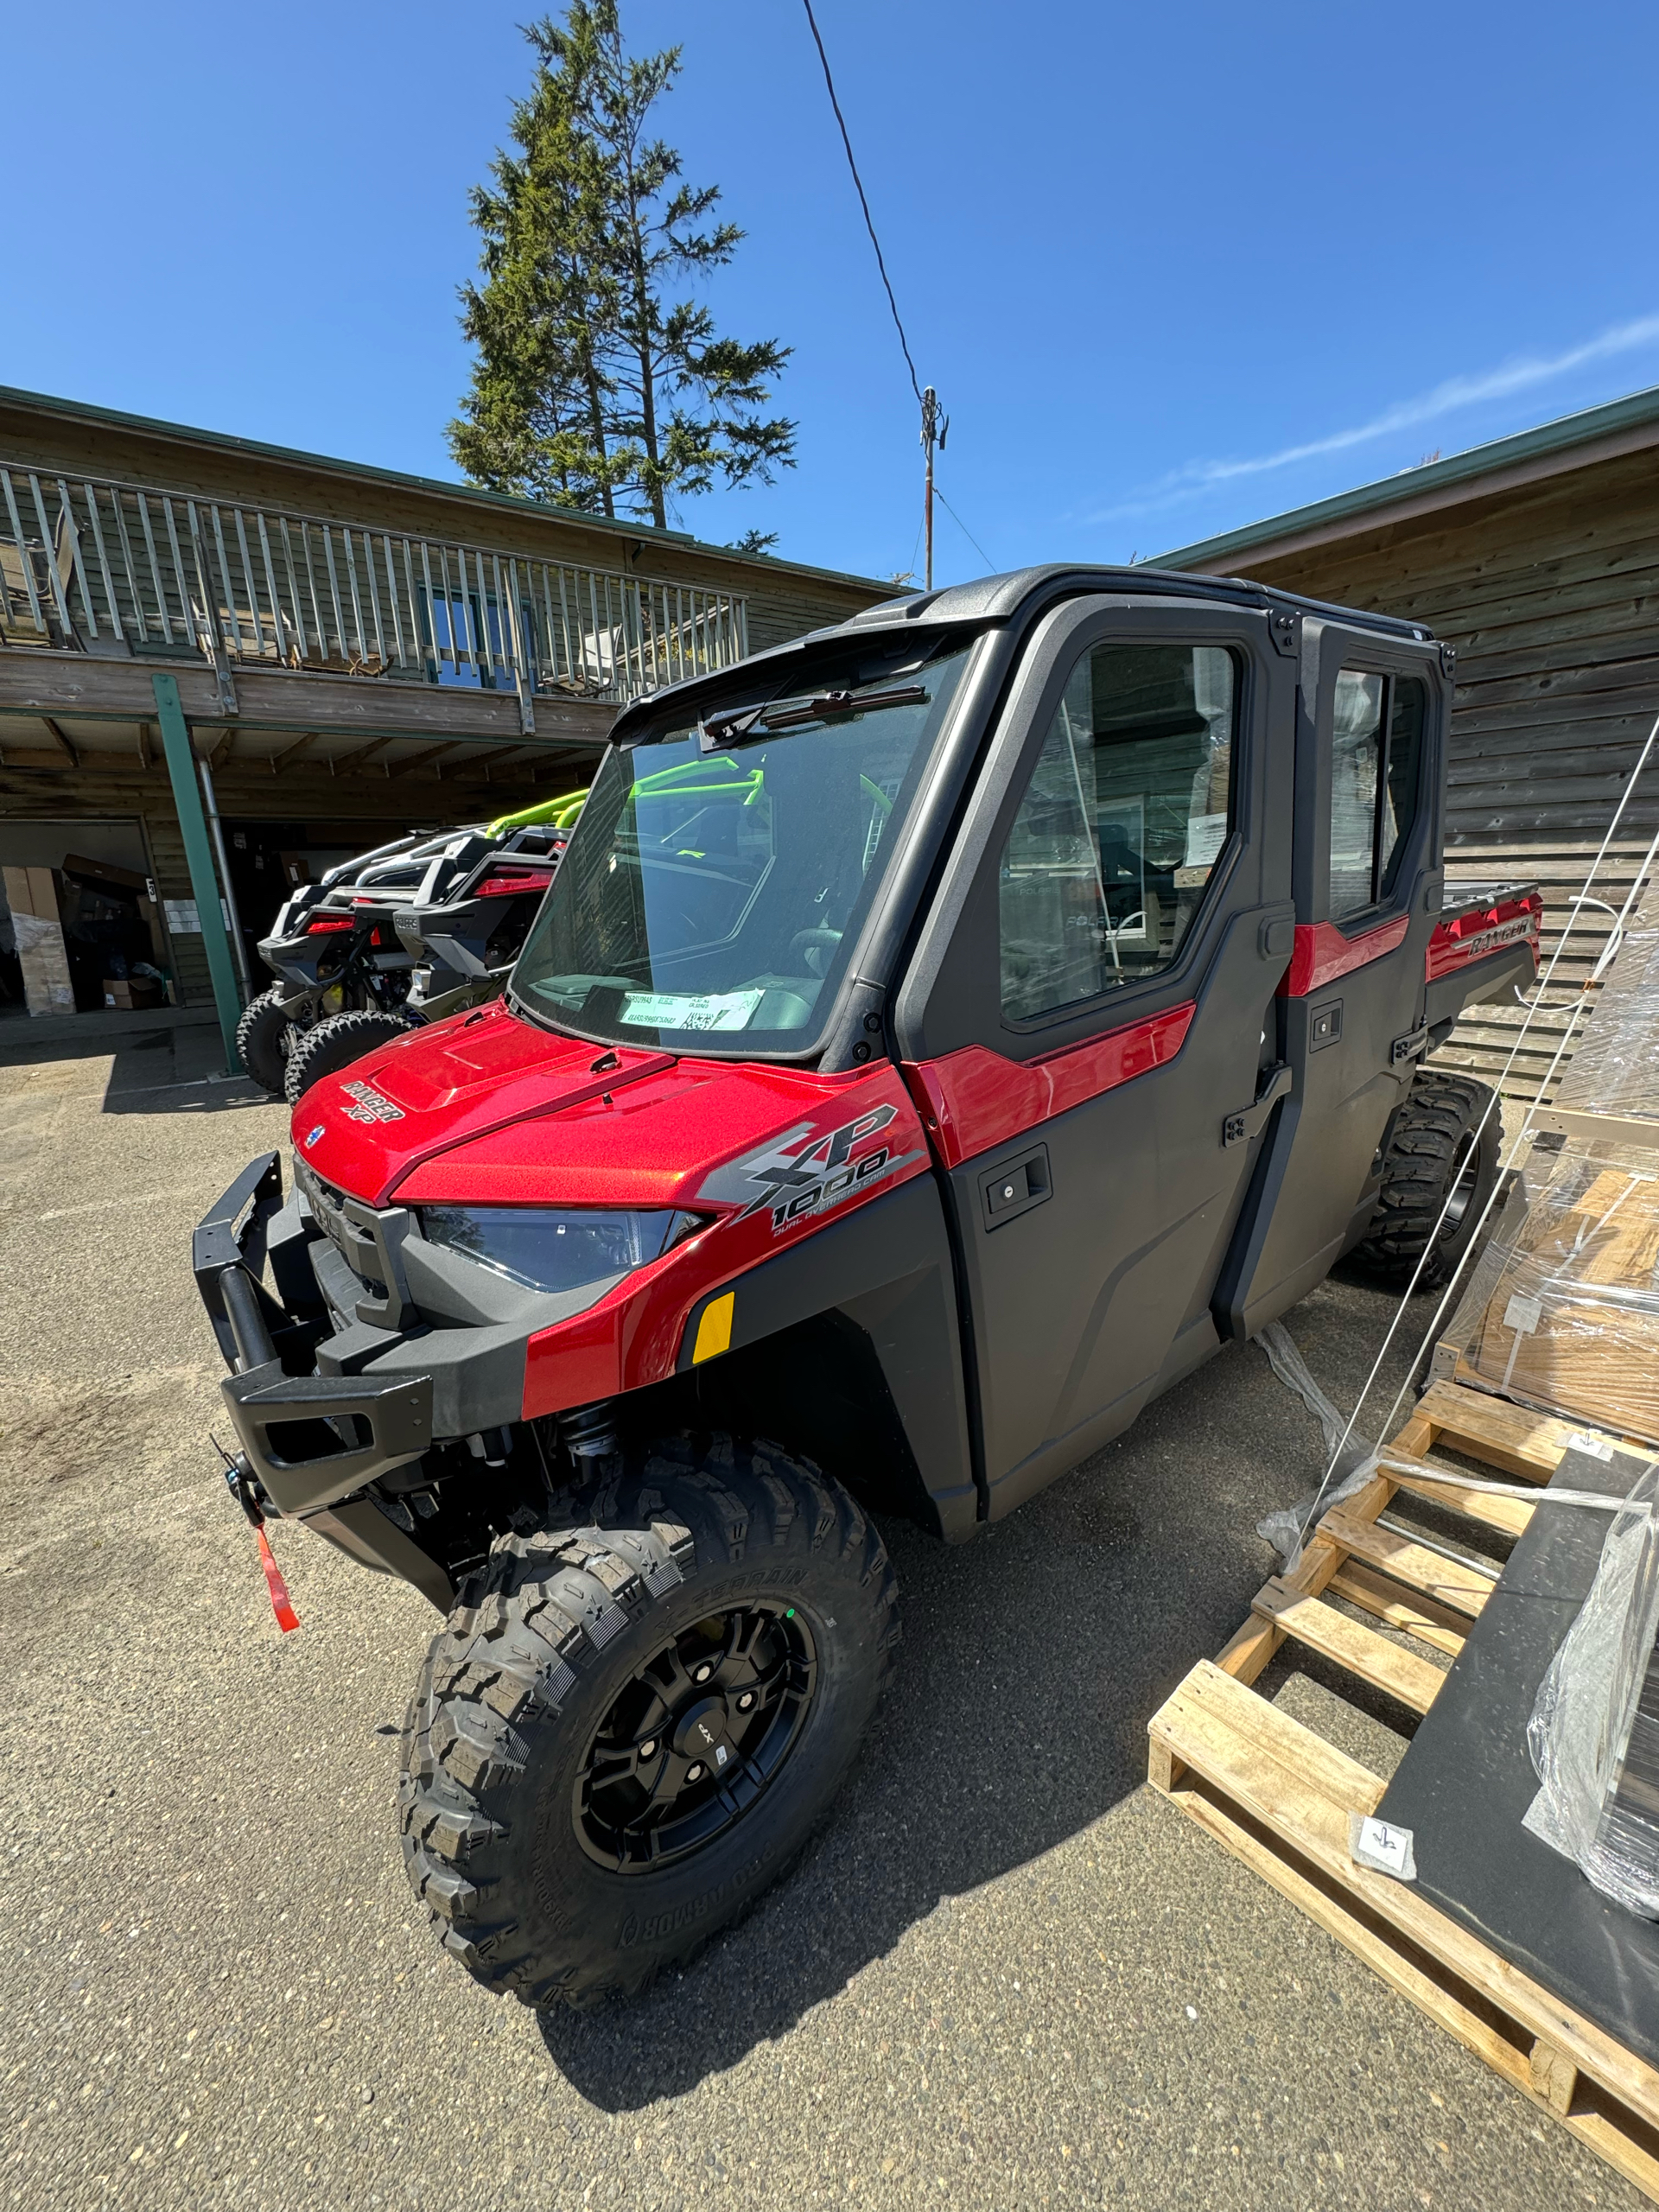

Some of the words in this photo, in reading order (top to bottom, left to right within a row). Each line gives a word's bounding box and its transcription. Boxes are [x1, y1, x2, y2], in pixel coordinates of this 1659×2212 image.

[1020, 887, 1061, 896] POLARIS
[1065, 915, 1135, 928] POLARIS
[1467, 918, 1529, 958] RANGER
[339, 1080, 406, 1123] RANGER
[339, 1103, 377, 1124] XP
[728, 1103, 899, 1227] XP
[772, 1147, 890, 1231] 1000
[773, 1218, 803, 1238] DUAL
[804, 1183, 861, 1219] OVERHEAD
[862, 1169, 886, 1185] CAM
[697, 1723, 715, 1744] XP
[642, 1882, 725, 1941] ARMOR
